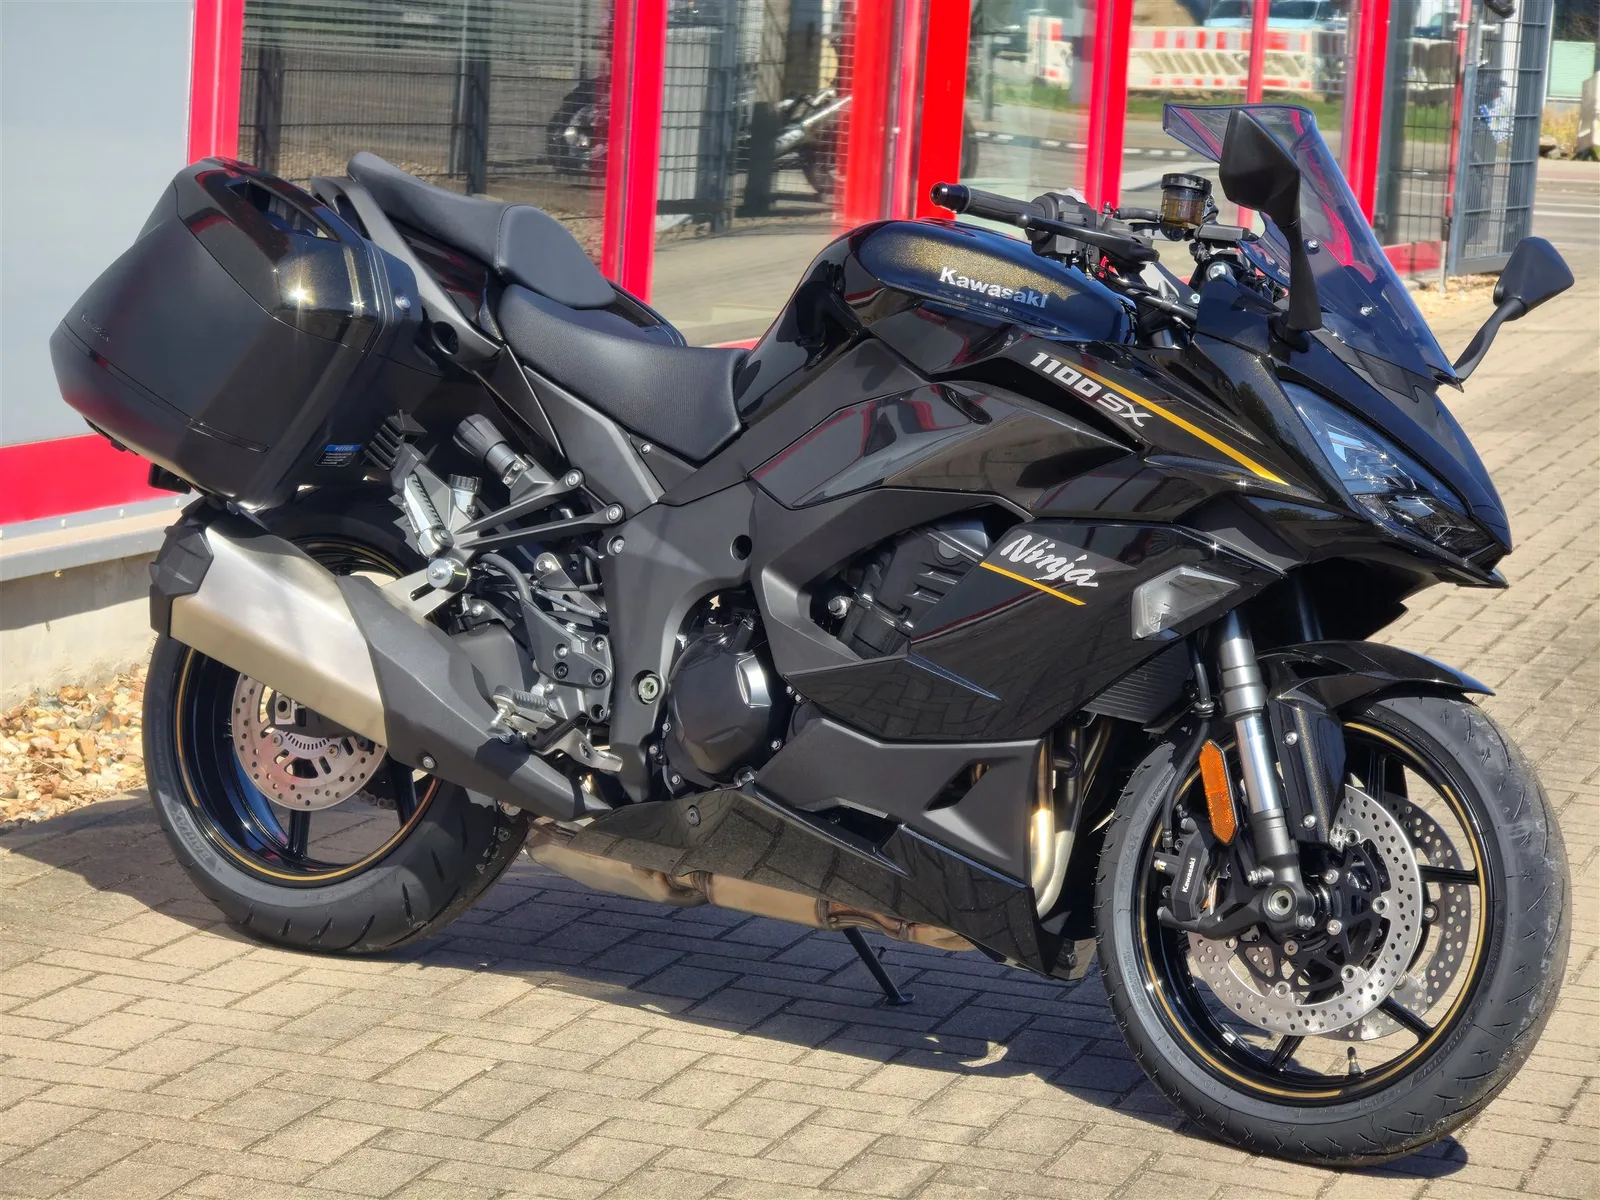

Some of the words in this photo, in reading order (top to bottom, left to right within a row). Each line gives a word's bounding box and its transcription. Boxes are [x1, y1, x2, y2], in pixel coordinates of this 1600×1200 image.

[939, 266, 1049, 309] Kawasaki
[1000, 535, 1099, 587] Ninja
[1181, 857, 1196, 893] Kawasaki
